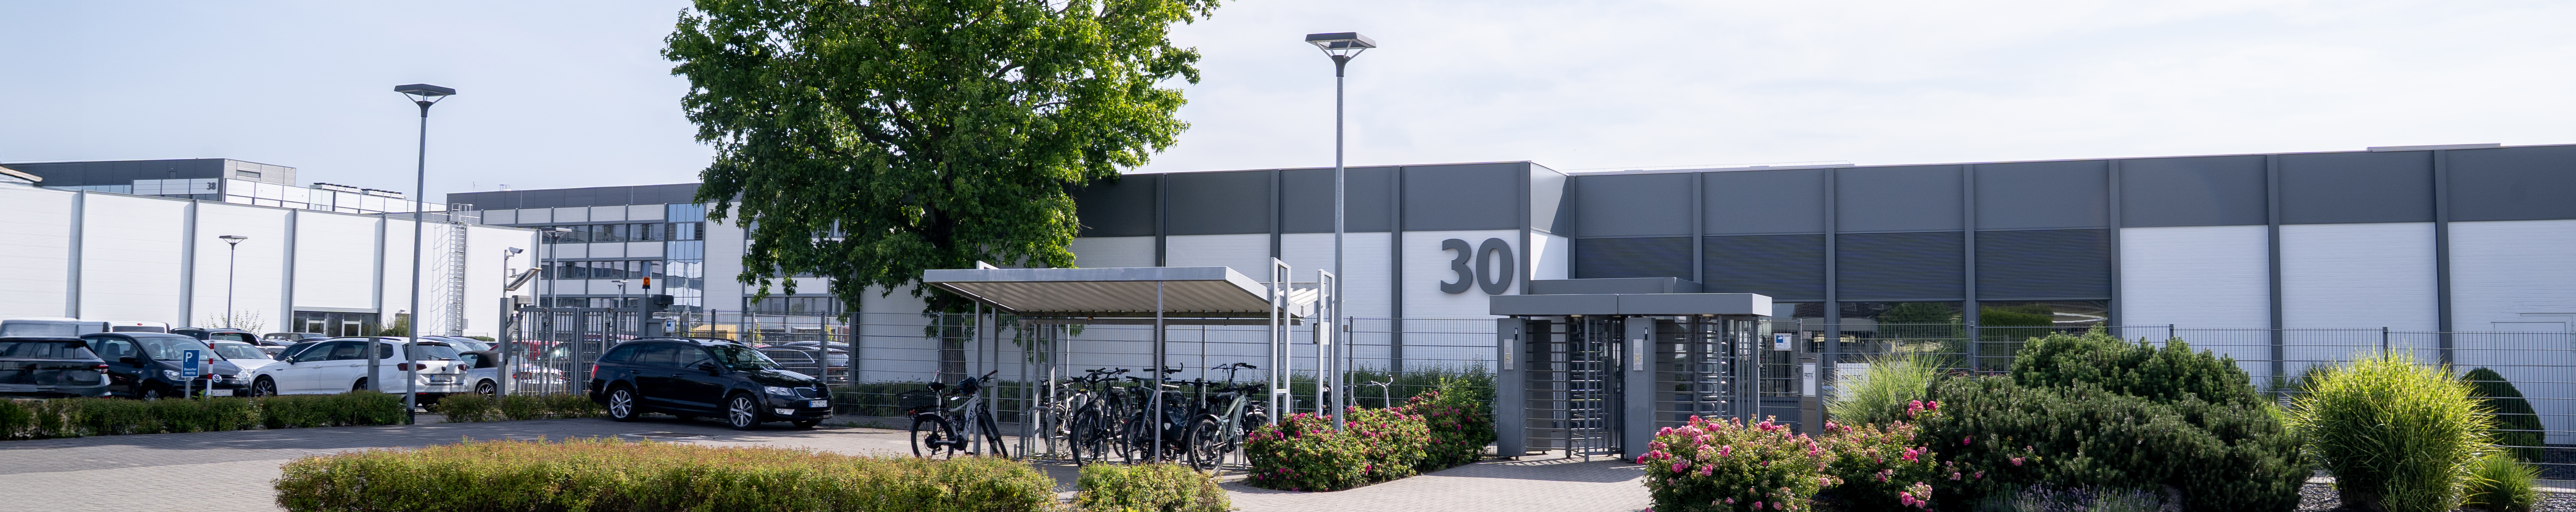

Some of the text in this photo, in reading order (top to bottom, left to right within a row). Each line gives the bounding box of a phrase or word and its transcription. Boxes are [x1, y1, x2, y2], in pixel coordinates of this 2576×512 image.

[207, 182, 216, 190] 38
[1440, 237, 1514, 295] 30
[185, 352, 193, 362] P
